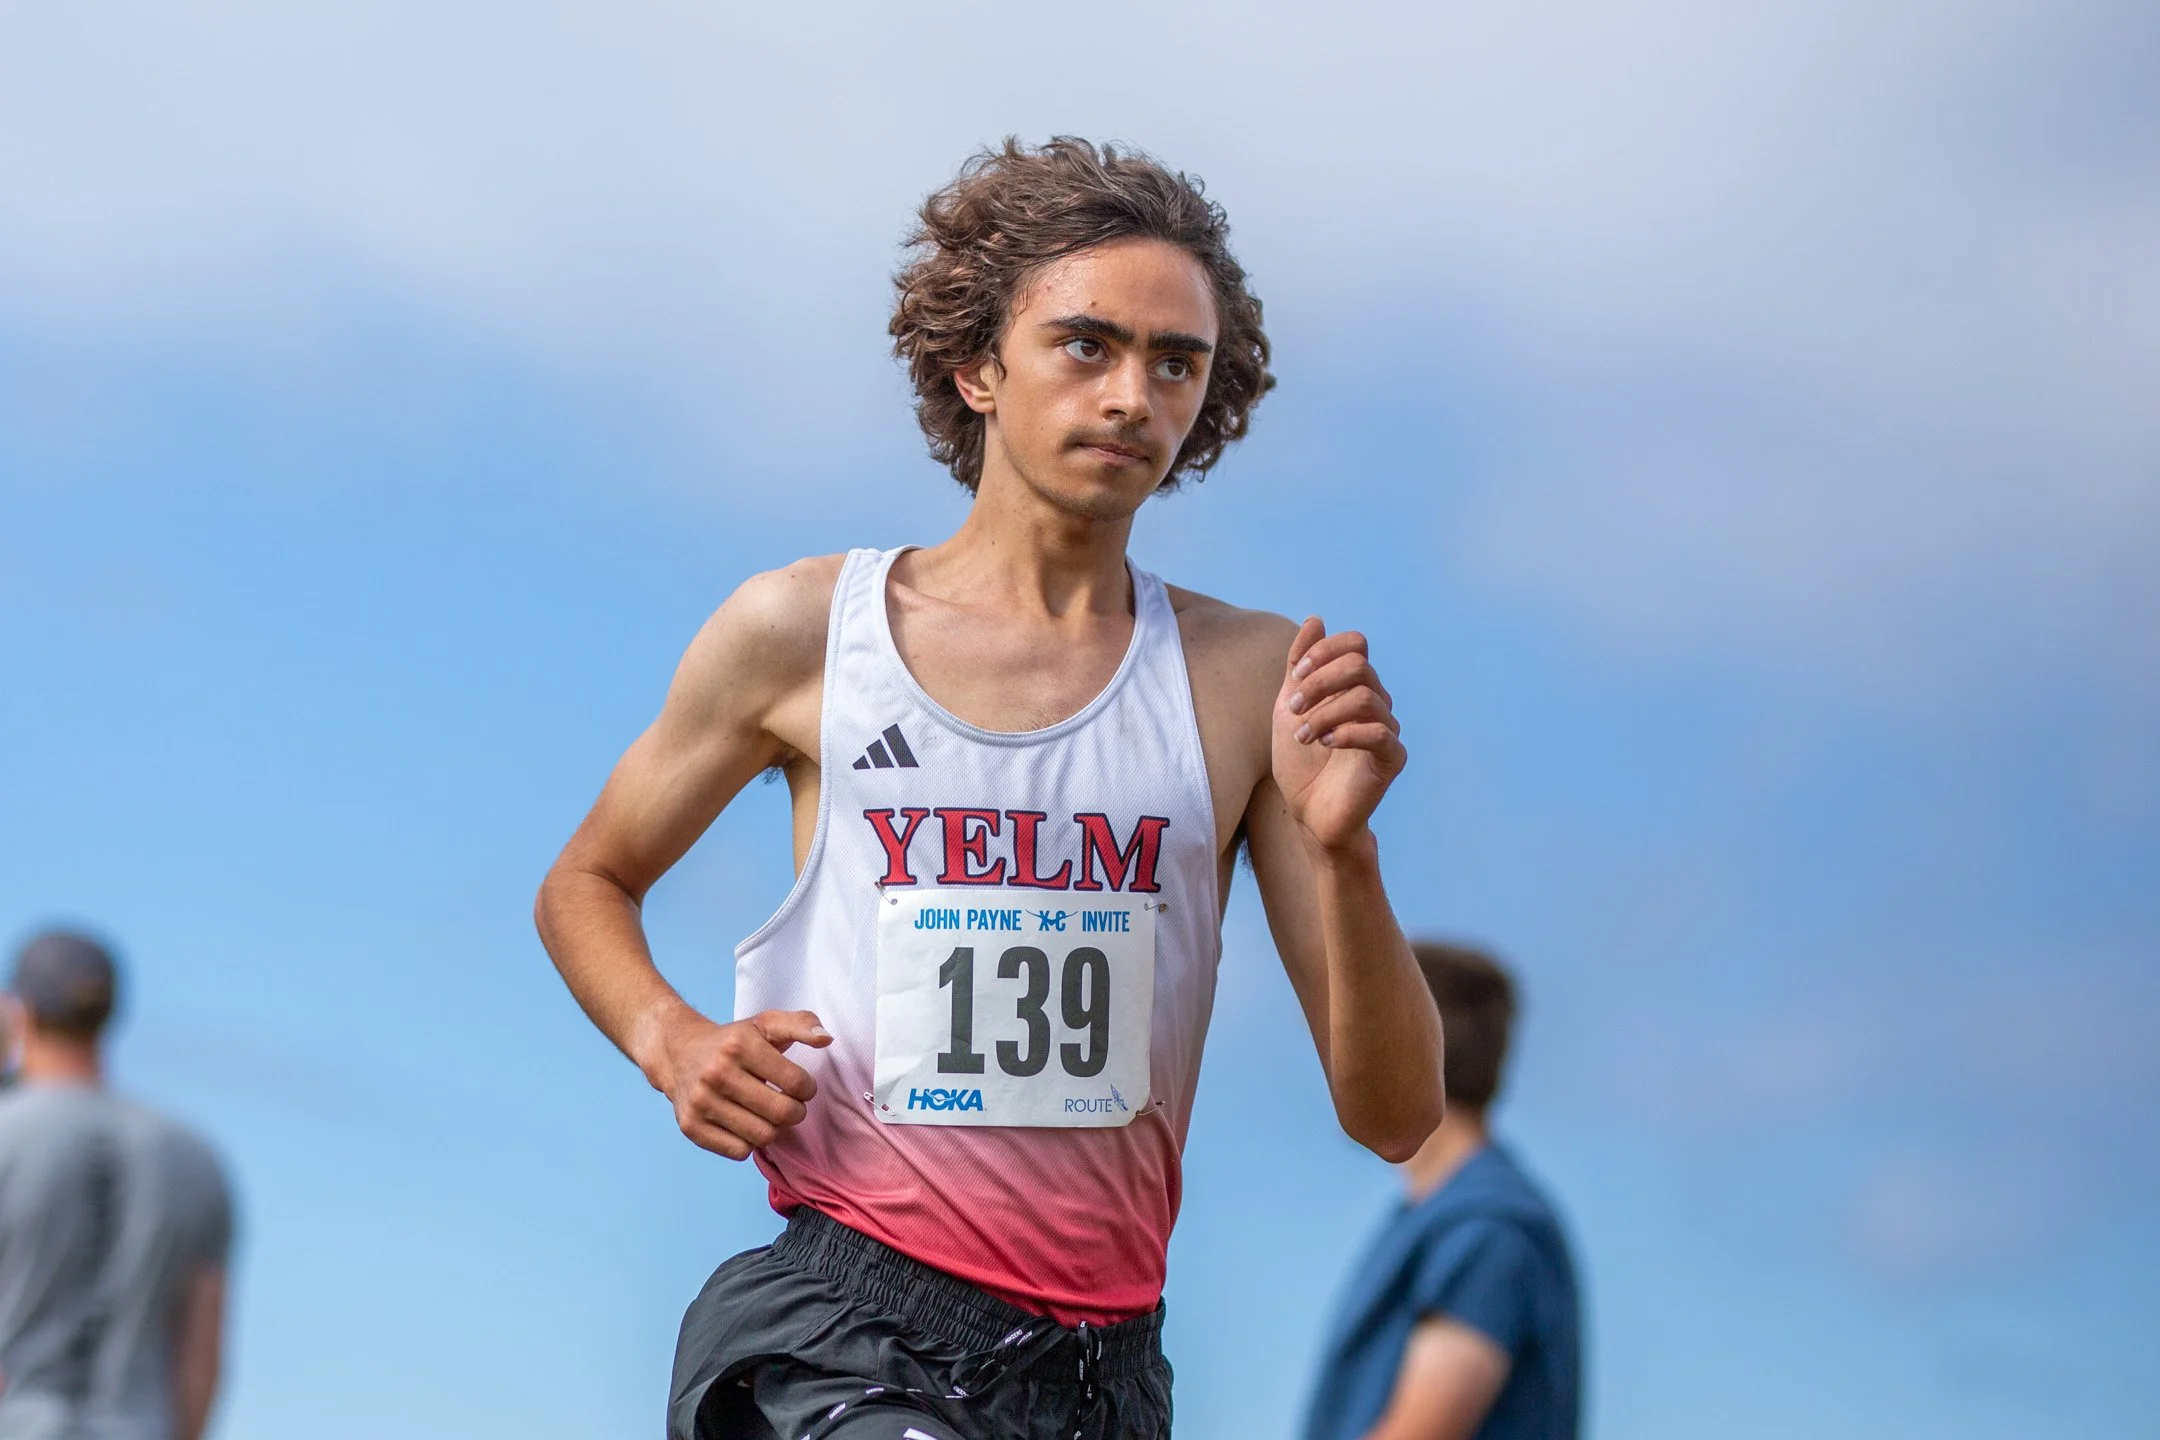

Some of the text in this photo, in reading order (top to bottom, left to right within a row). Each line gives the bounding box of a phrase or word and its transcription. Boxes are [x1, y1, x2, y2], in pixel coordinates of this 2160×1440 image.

[863, 807, 1170, 893] YELM
[914, 908, 960, 930] JOHN
[967, 909, 1022, 931] PAYNE
[1082, 911, 1130, 932] INVITE
[936, 946, 1111, 1077] 139
[907, 1088, 984, 1112] HOKA
[1064, 1098, 1113, 1113] ROUTE
